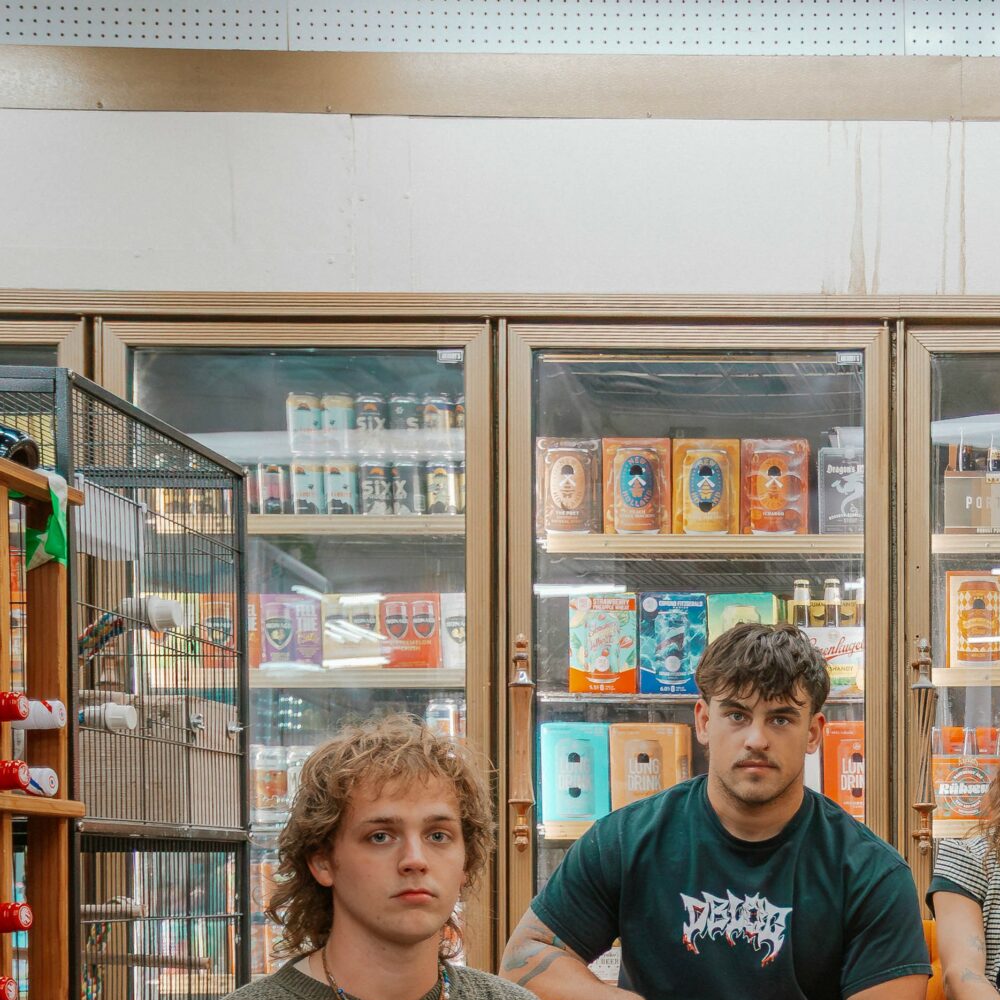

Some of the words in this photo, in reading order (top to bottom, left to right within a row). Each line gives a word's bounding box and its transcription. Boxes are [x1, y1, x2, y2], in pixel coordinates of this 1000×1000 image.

[826, 464, 856, 475] Dragon's
[629, 759, 661, 775] LONG
[842, 757, 864, 774] LON
[627, 775, 662, 792] DRINK
[841, 774, 864, 791] DRIN
